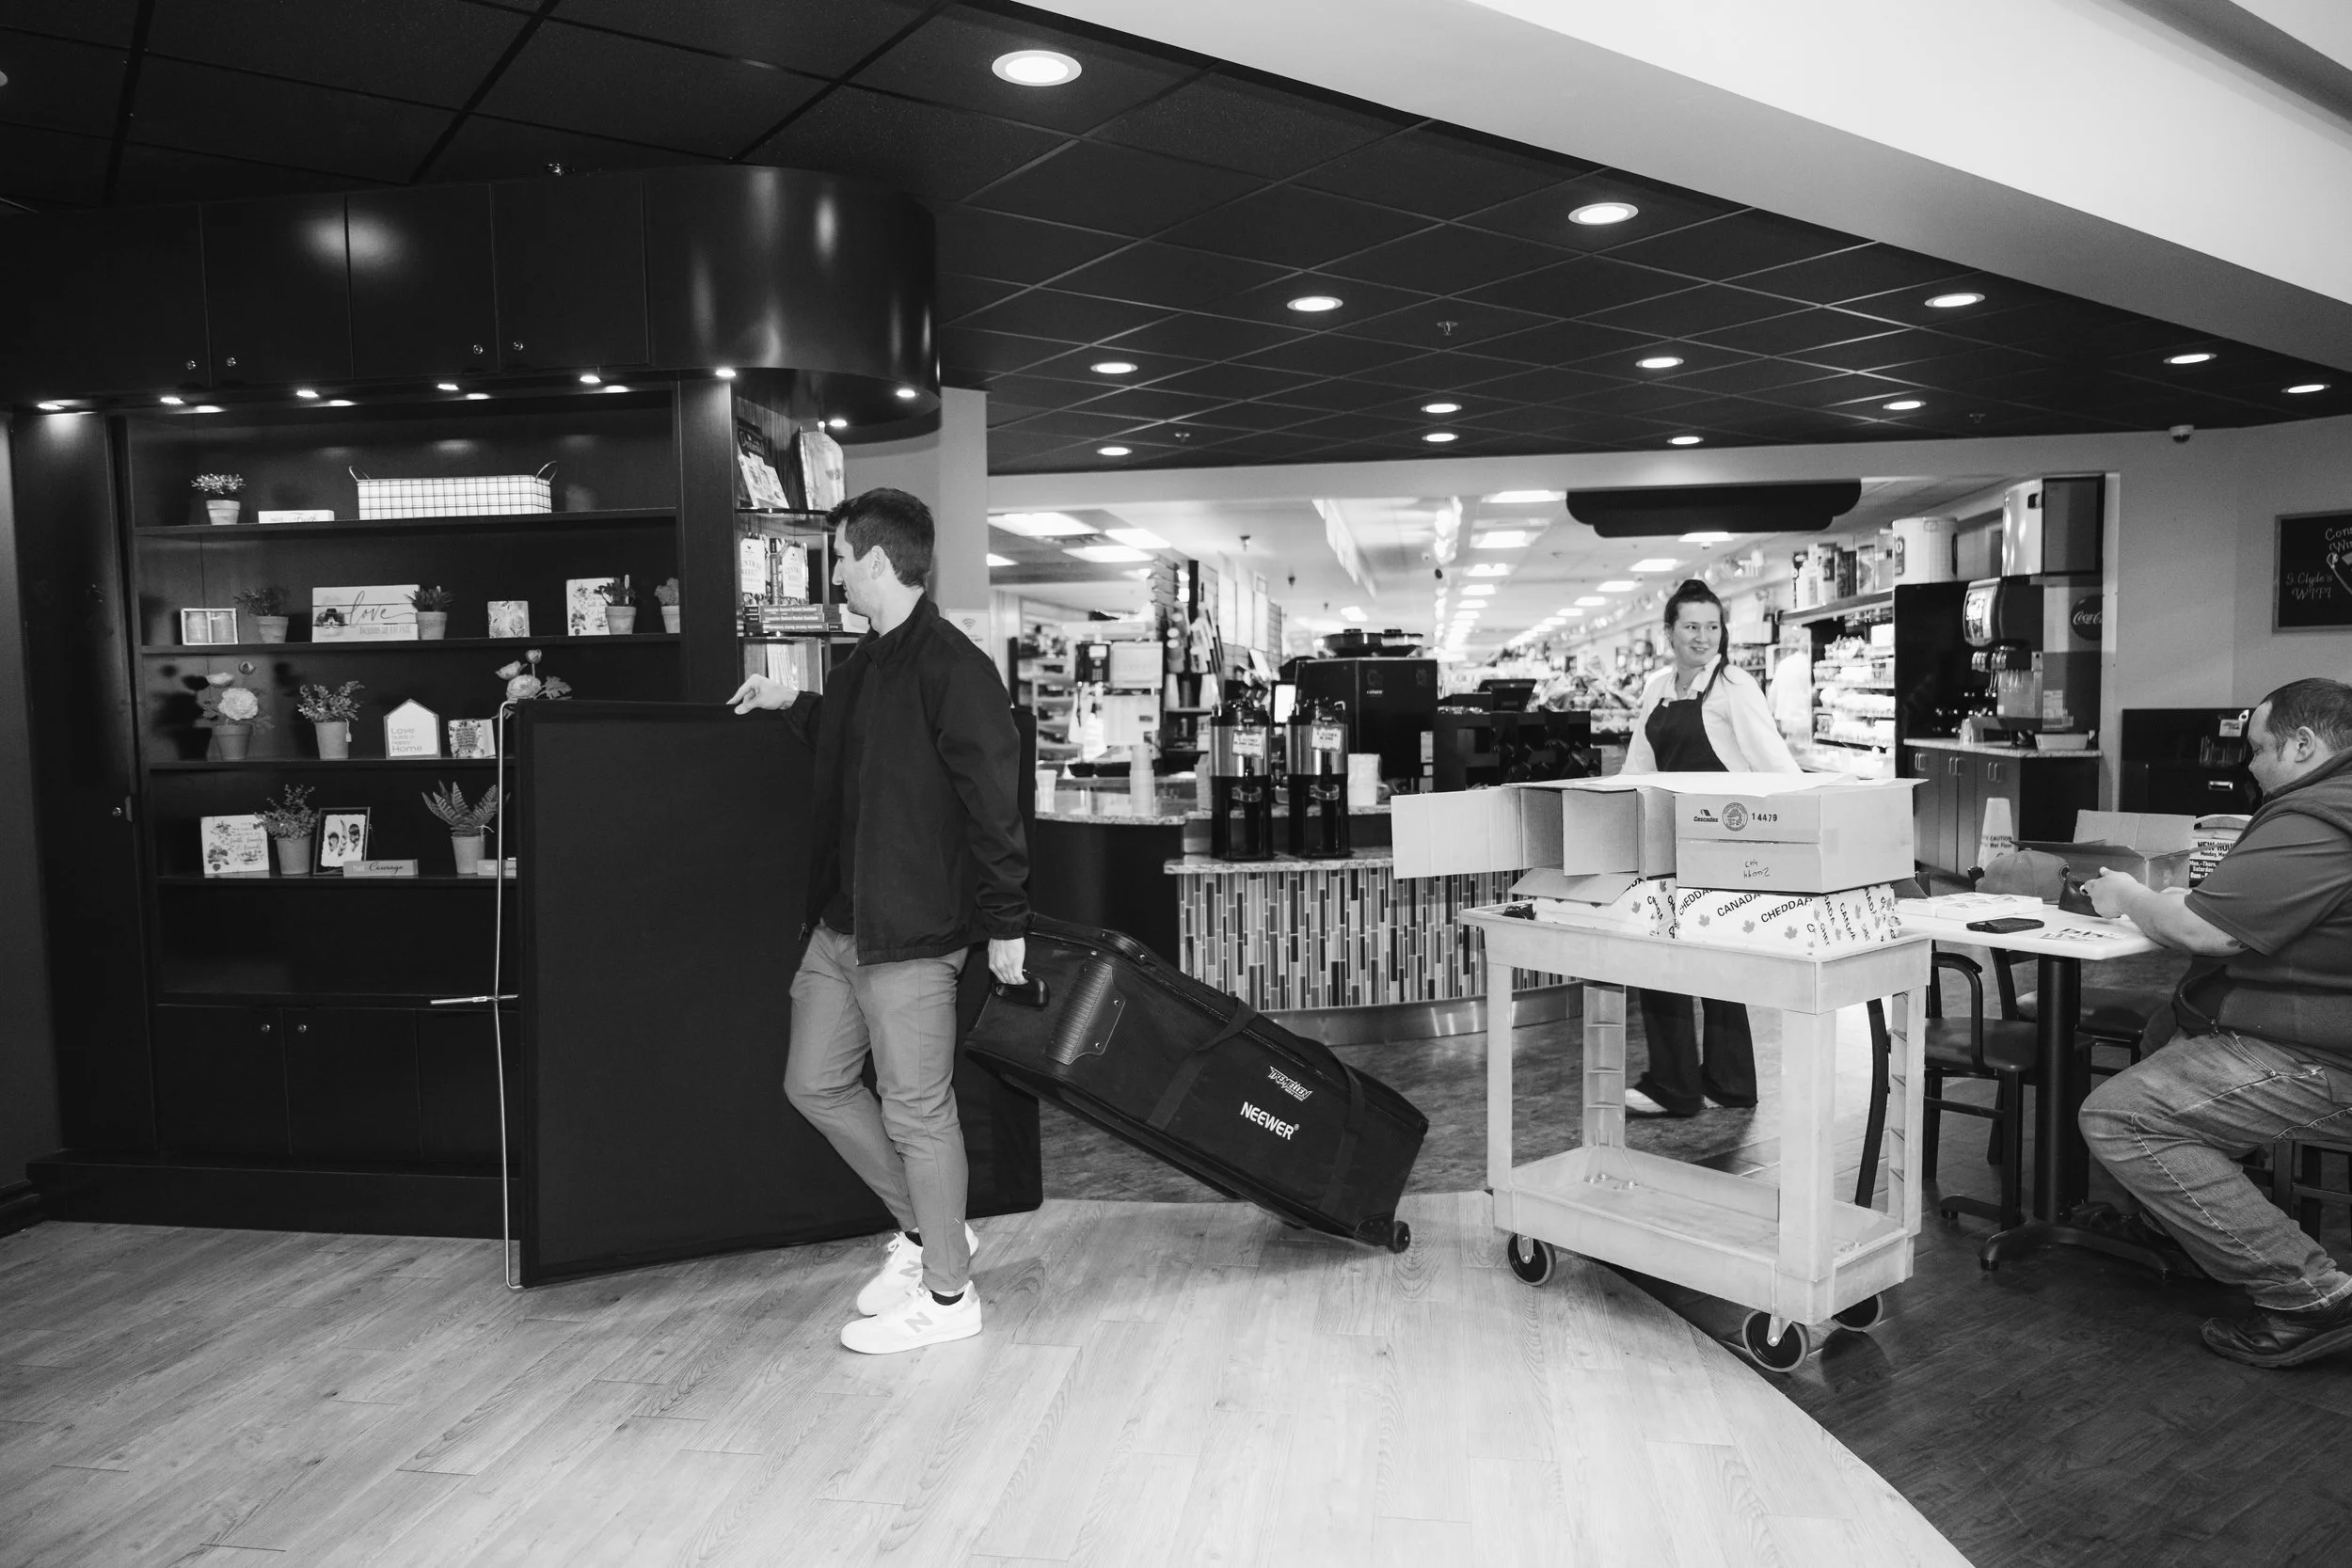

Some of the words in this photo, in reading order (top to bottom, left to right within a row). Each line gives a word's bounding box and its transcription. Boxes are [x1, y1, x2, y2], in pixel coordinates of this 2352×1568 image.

[349, 590, 414, 627] love
[1752, 813, 1778, 822] 14479
[369, 861, 405, 875] Courage
[1678, 889, 1713, 916] CHEDDA
[1717, 893, 1761, 917] CANADA
[904, 1311, 933, 1334] N
